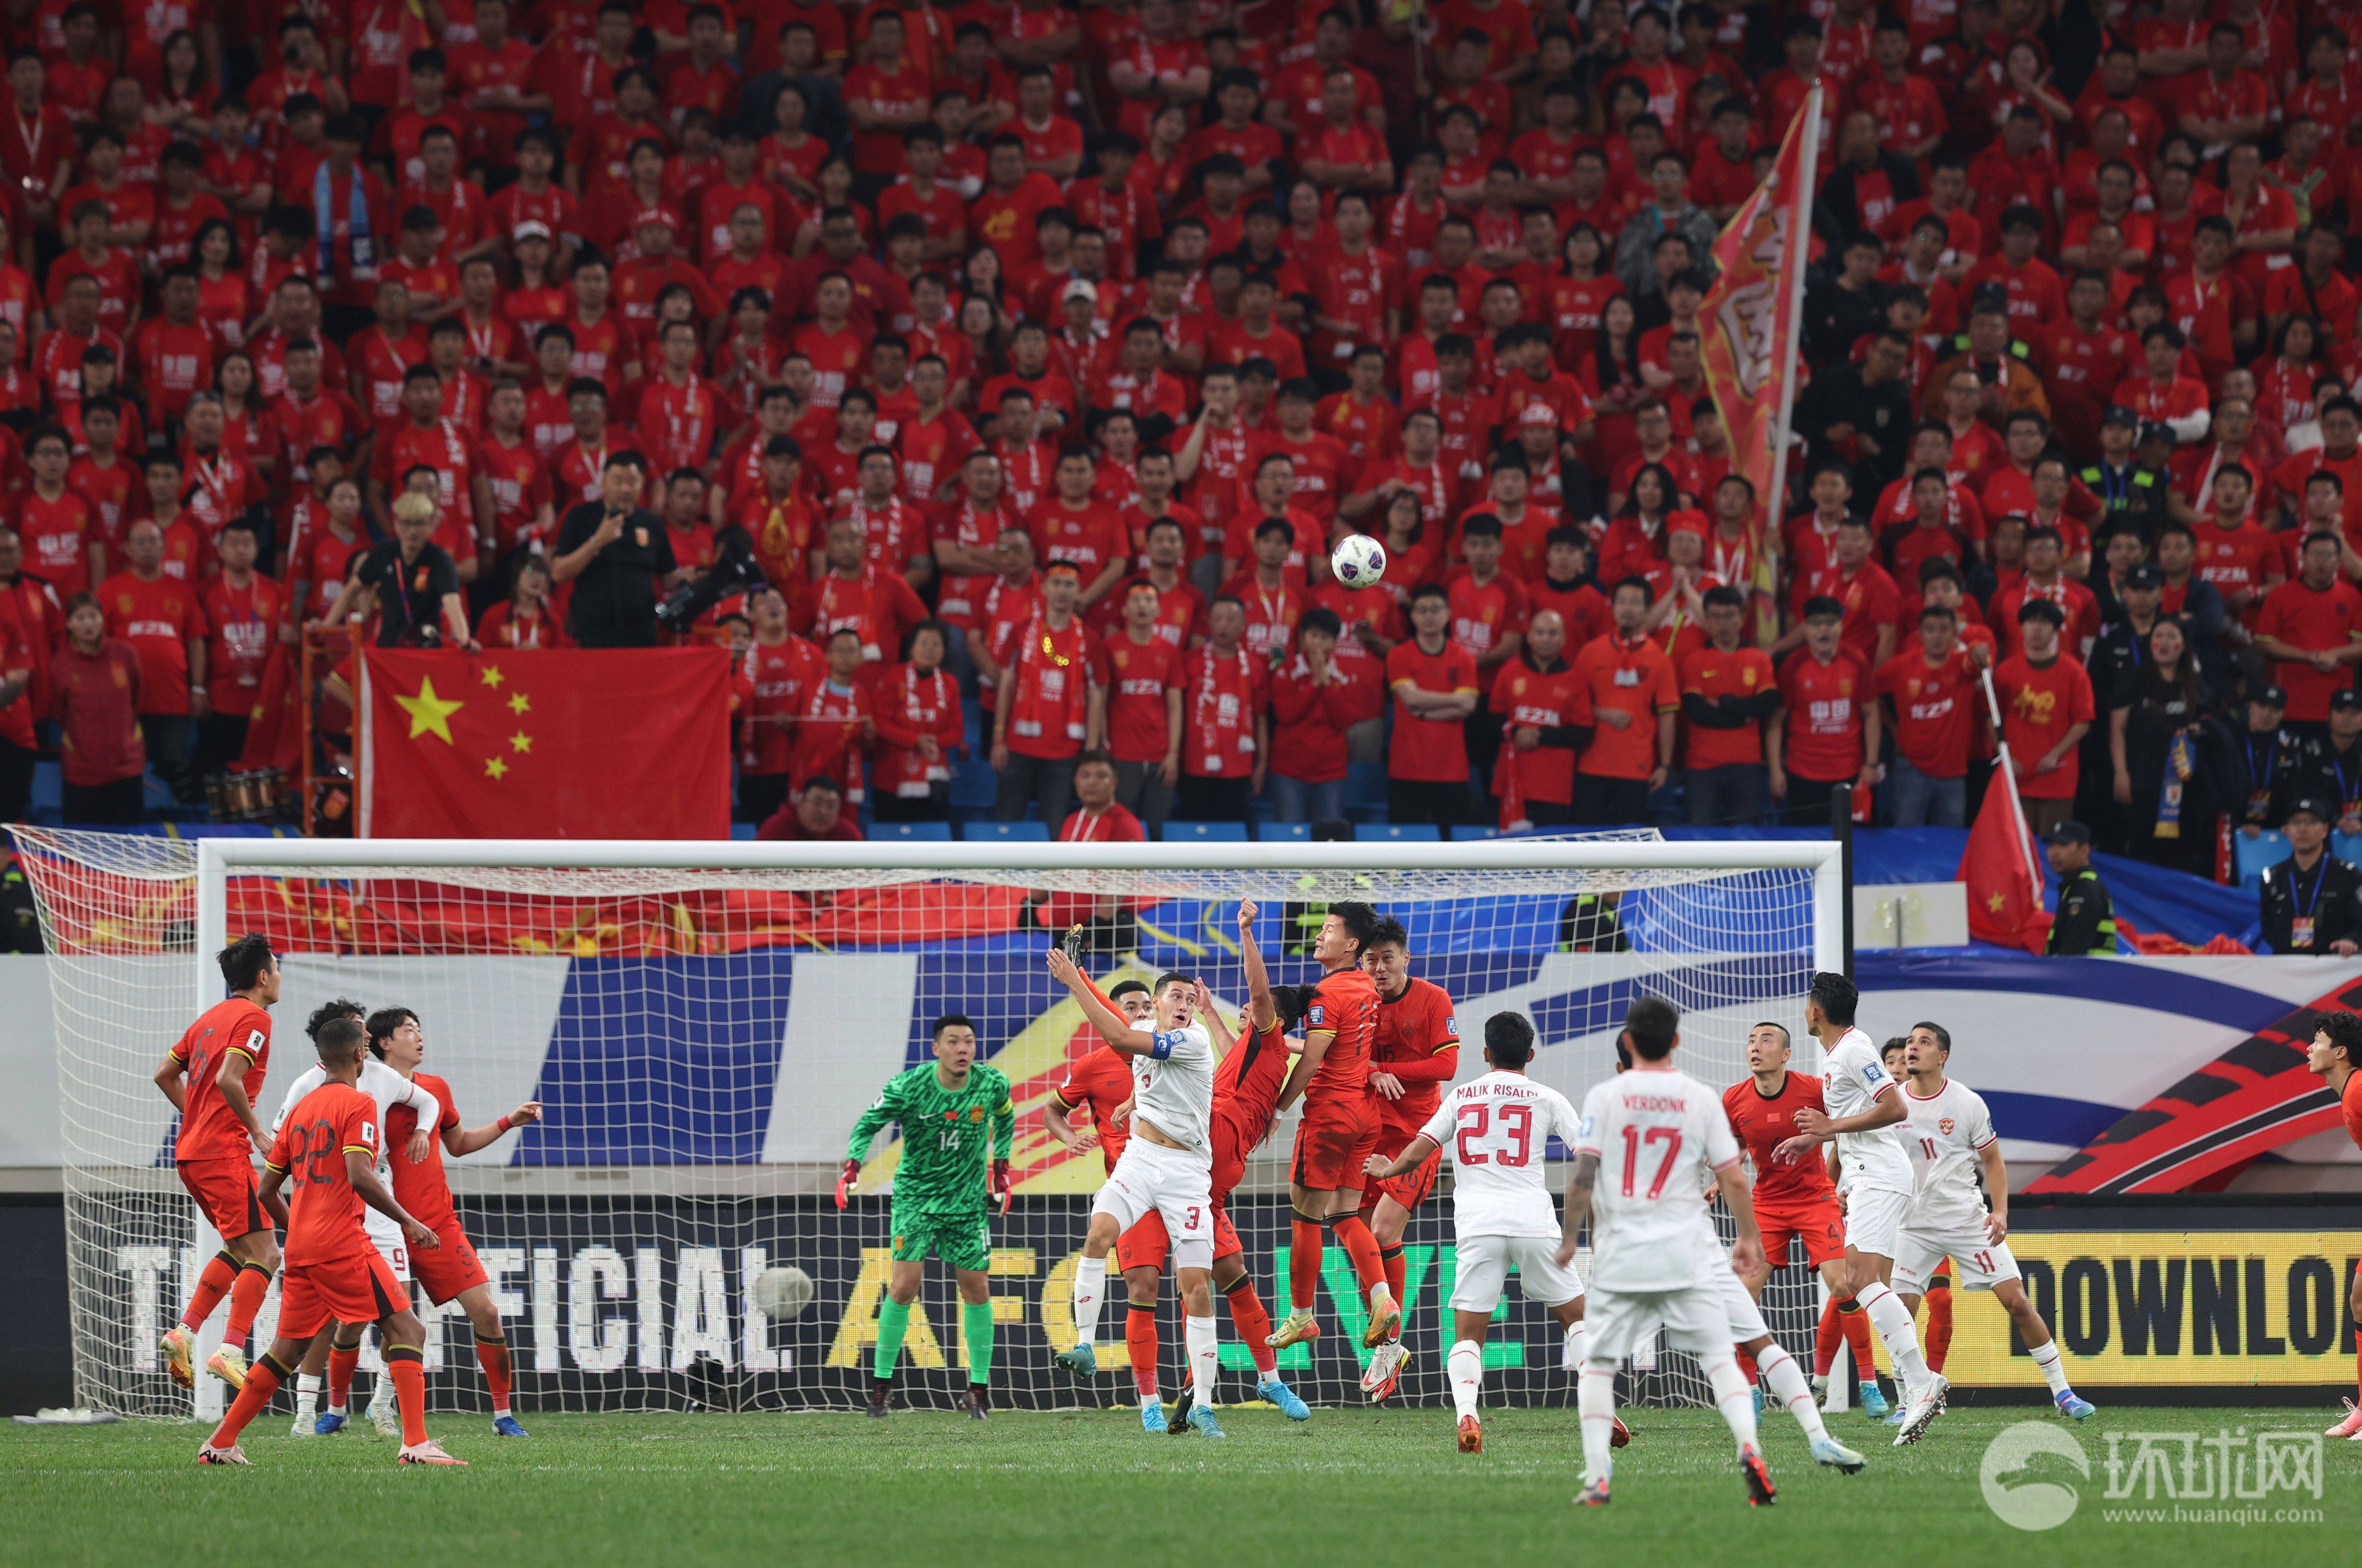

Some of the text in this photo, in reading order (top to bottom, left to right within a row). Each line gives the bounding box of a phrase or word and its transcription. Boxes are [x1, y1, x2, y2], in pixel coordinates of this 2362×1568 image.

[190, 1027, 215, 1087] 6
[1456, 1084, 1489, 1100] MALIK
[1622, 1094, 1688, 1114] VERDONK
[939, 1129, 960, 1151] 14
[1456, 1103, 1532, 1168] 23
[290, 1119, 336, 1188] 22
[1920, 1138, 1938, 1160] 11
[1621, 1124, 1682, 1199] 17
[1115, 1179, 1130, 1194] erspo
[1185, 1206, 1200, 1230] 3
[1827, 1221, 1841, 1242] 4
[393, 1248, 406, 1272] 9
[456, 1244, 474, 1267] 3
[1974, 1250, 1996, 1274] 11
